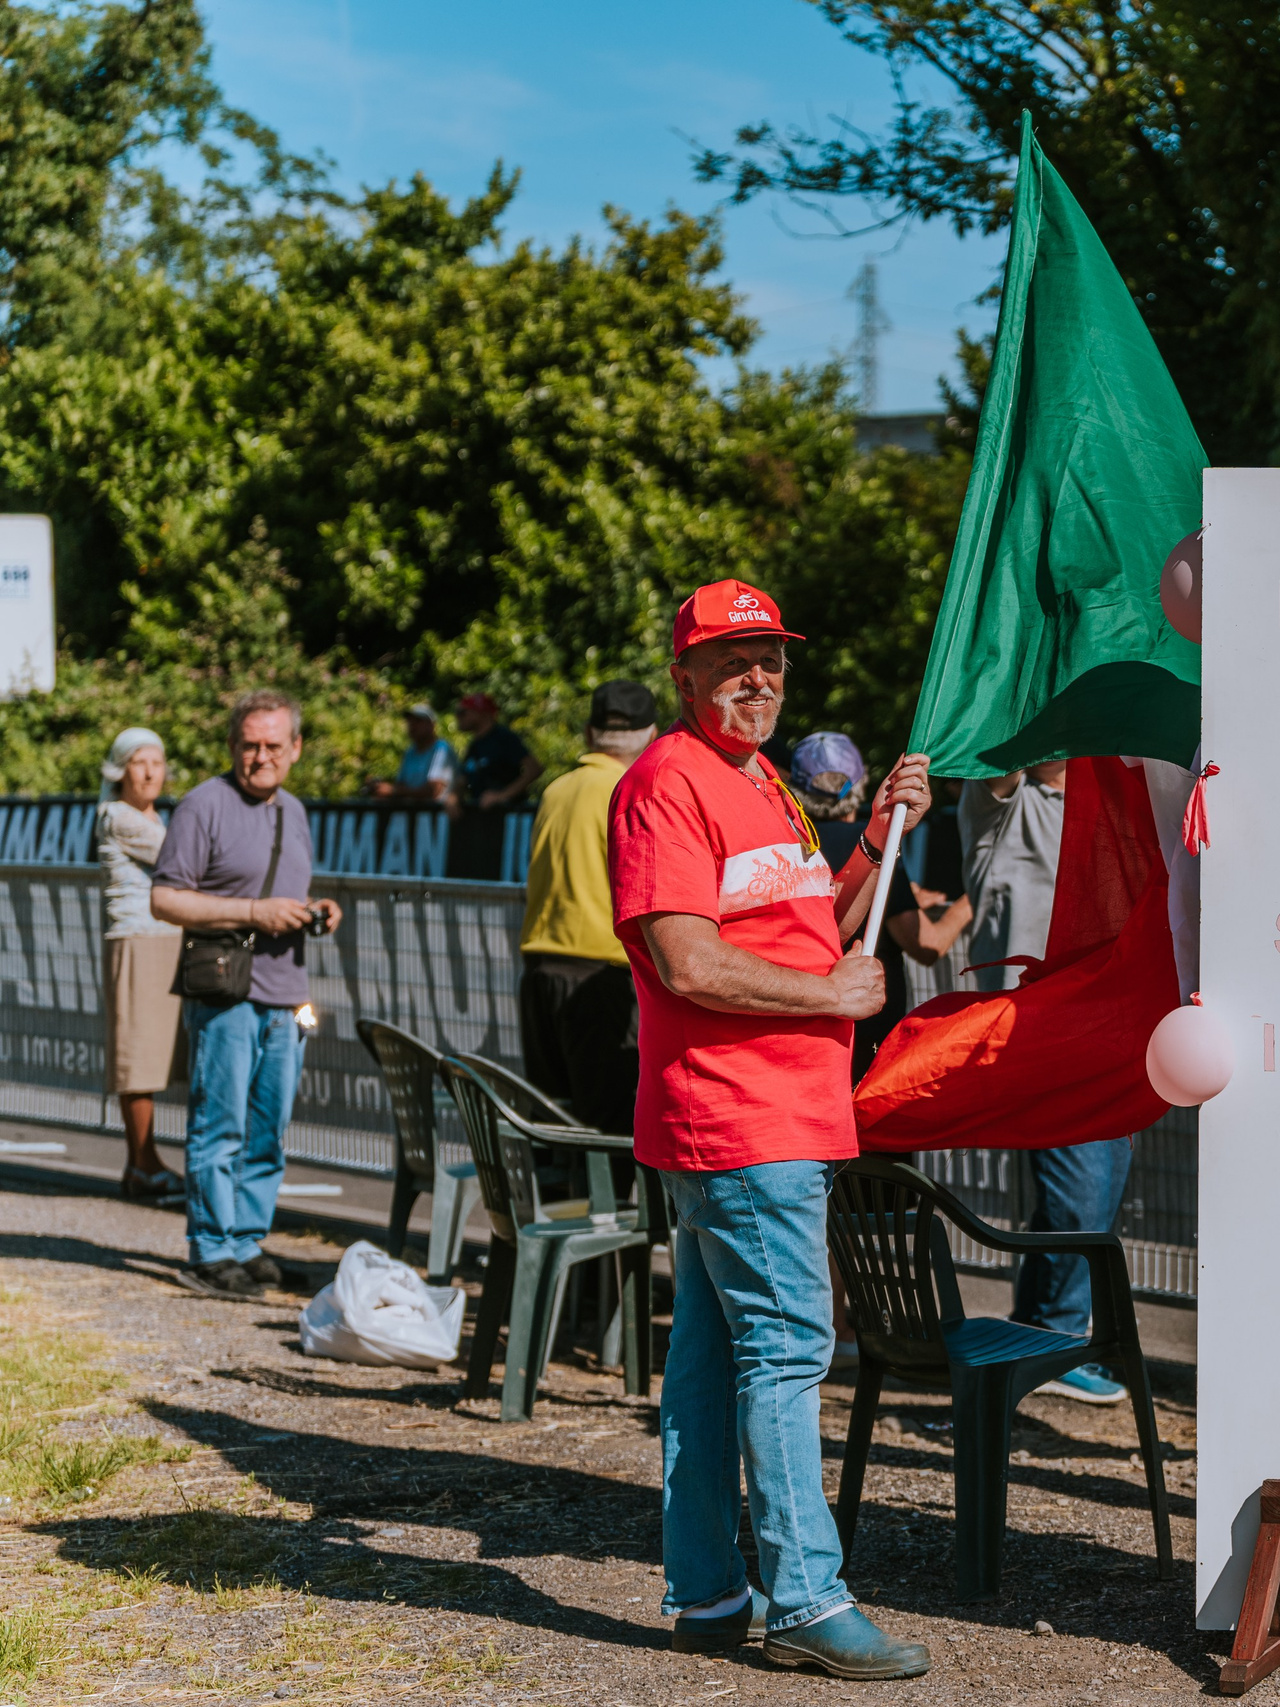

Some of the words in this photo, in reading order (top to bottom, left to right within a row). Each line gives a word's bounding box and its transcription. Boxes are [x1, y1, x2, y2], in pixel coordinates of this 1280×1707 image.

[728, 611, 747, 623] Giro
[747, 610, 772, 622] d'Italia
[0, 803, 96, 863] MAN
